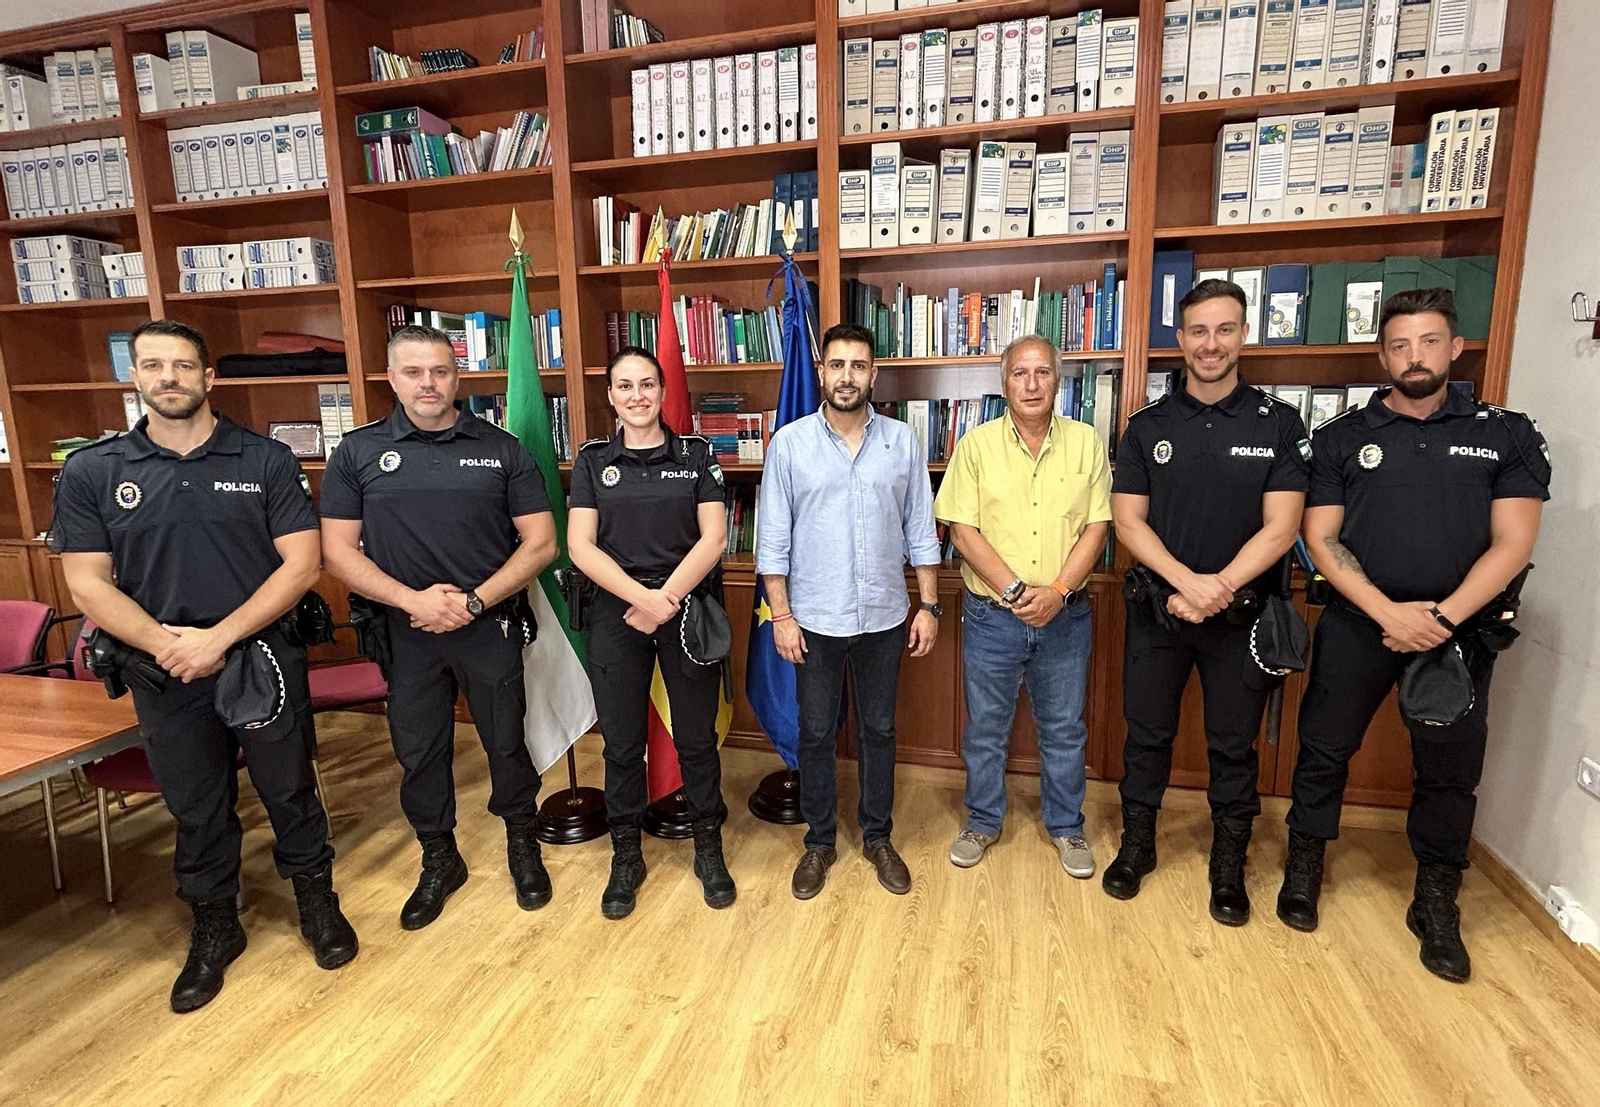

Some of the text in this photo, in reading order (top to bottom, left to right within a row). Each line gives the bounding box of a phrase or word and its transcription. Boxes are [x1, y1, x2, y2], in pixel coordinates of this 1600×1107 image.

[1427, 151, 1439, 193] FORMACIÓN
[1434, 137, 1447, 192] UNIVERSITARIA
[1449, 149, 1460, 192] FORMACIÓN
[1456, 136, 1469, 191] UNIVERSITARIA
[1472, 148, 1483, 190] FORMACIÓN
[1478, 135, 1491, 190] UNIVERSITARIA
[969, 310, 979, 343] Photoshop
[460, 459, 502, 468] POLICIA
[1230, 446, 1274, 458] POLICIA
[1450, 446, 1499, 461] POLICIA
[213, 481, 262, 493] POLICIA
[661, 470, 699, 479] POLICIA
